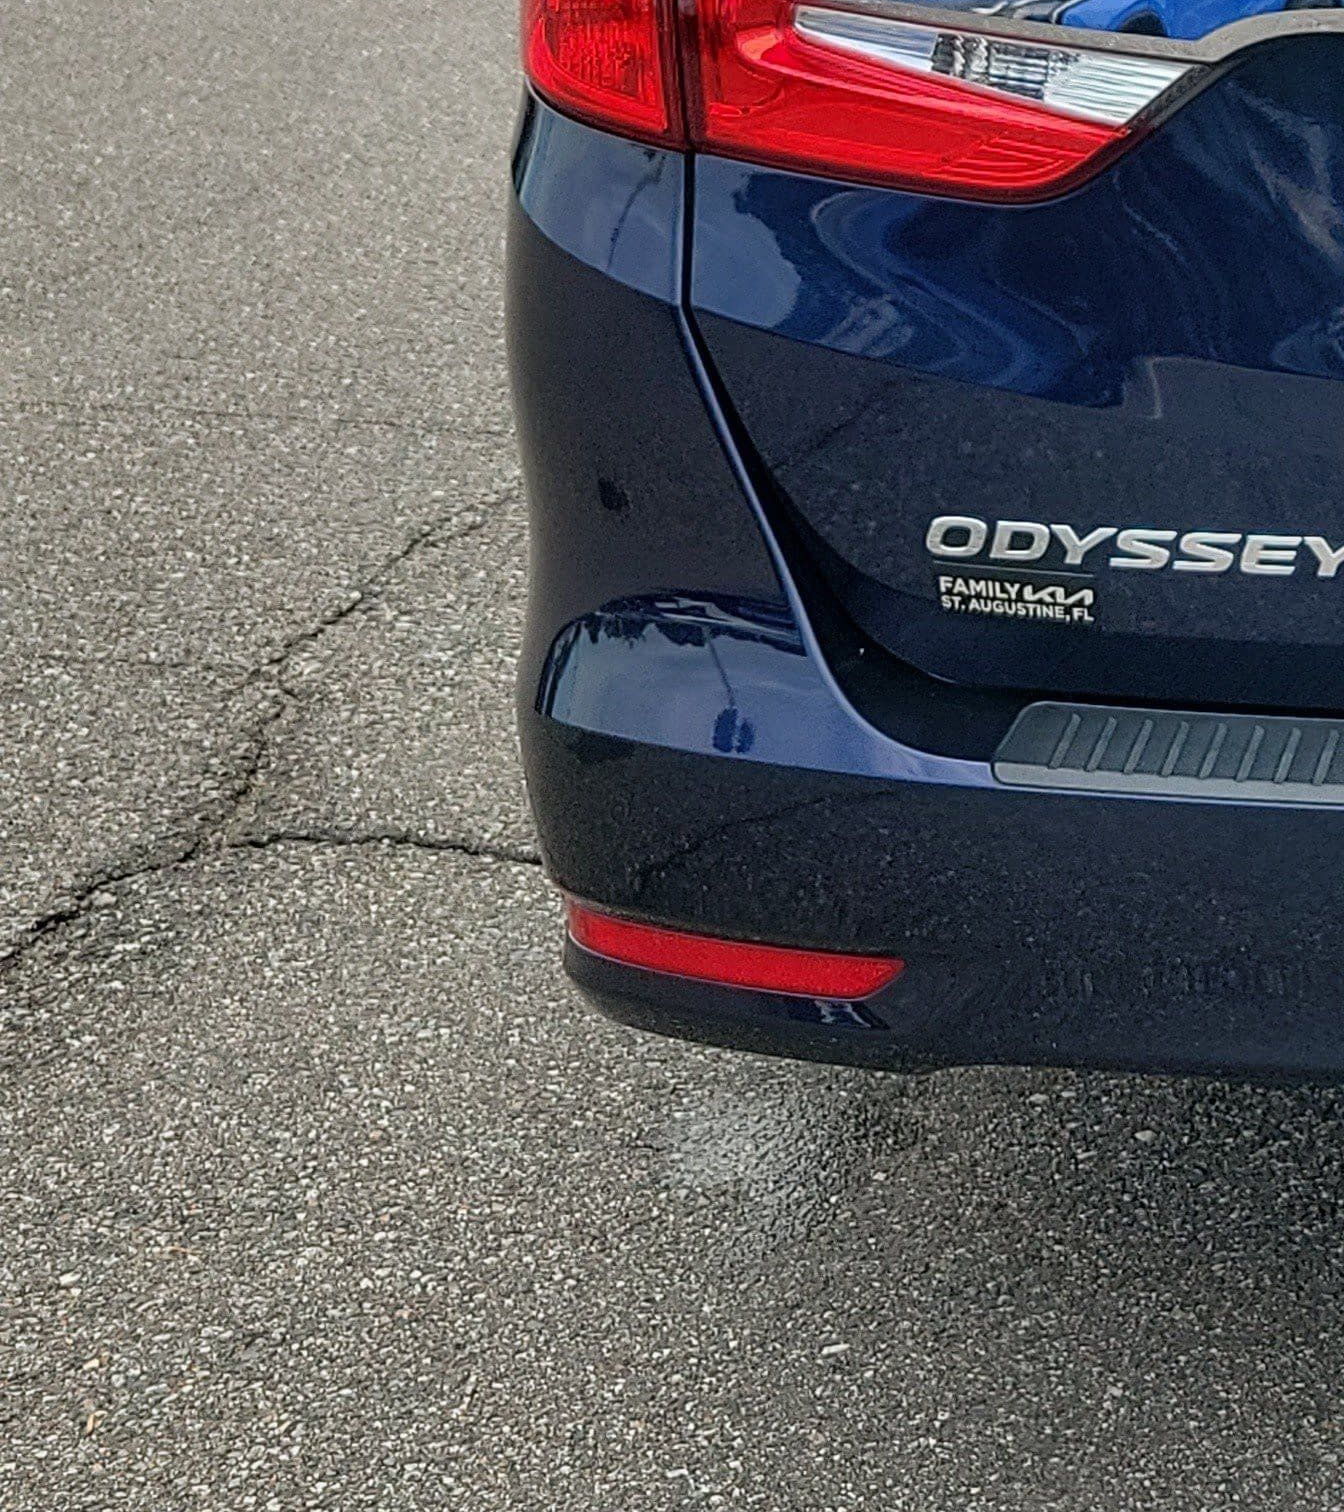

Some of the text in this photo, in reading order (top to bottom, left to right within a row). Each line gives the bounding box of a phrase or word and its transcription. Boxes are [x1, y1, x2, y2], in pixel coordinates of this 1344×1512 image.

[939, 575, 1020, 600] FAMILY
[941, 595, 1095, 622] ST. AUGUSTINE, FL
